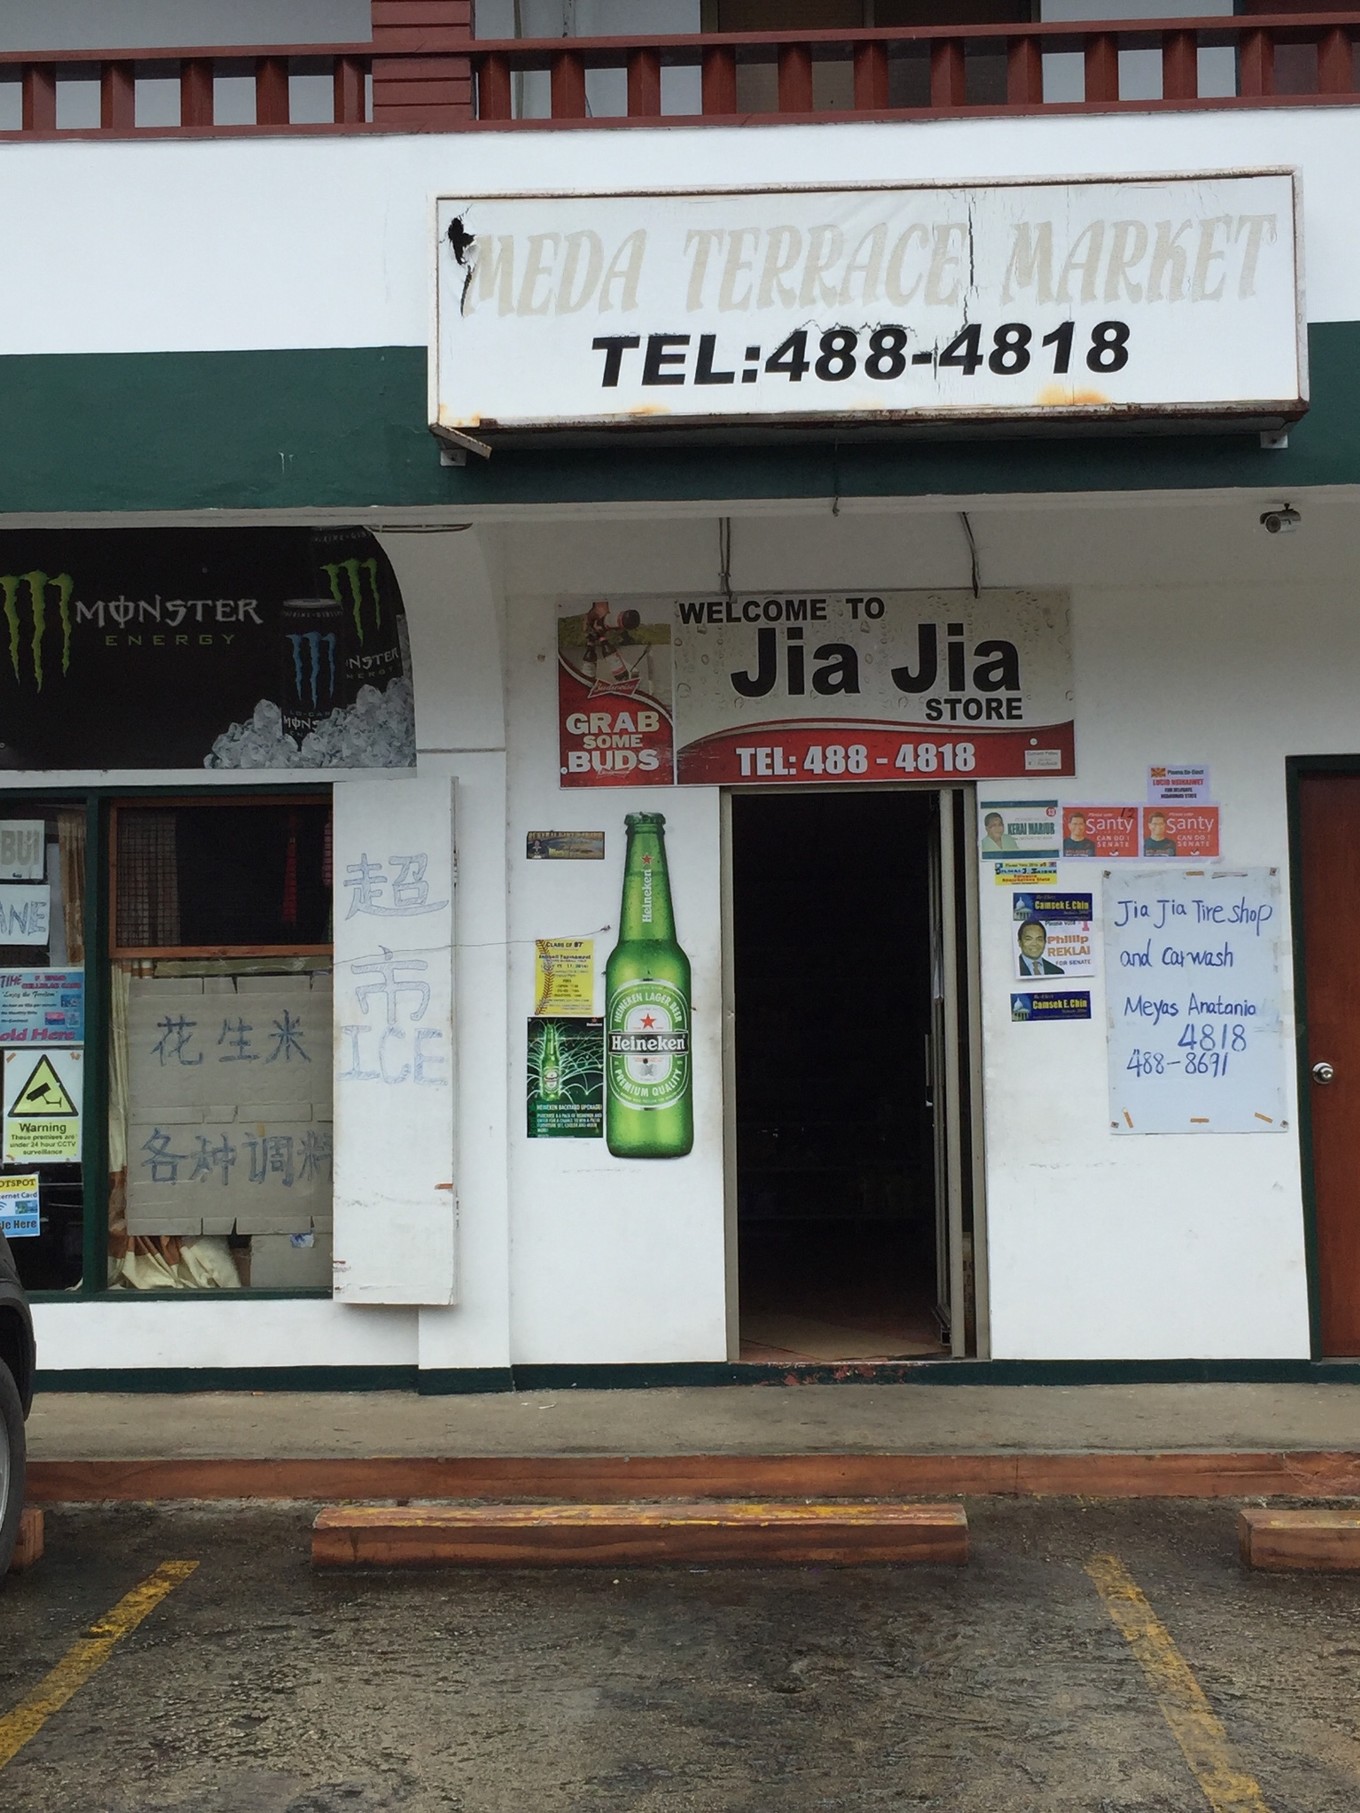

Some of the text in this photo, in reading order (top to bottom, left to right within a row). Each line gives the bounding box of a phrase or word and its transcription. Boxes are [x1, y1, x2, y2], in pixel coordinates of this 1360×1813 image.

[462, 213, 1278, 318] MEDA TERRACE MARKET
[679, 597, 886, 625] WELCOME TO
[105, 634, 236, 646] ENERGY
[729, 622, 1021, 698] Jia Jia
[925, 697, 1024, 721] STORE
[565, 711, 660, 735] GRAB
[582, 734, 643, 749] SOME
[568, 750, 660, 774] BUDS
[735, 747, 797, 776] TEL:
[803, 744, 869, 774] 488
[894, 742, 976, 772] 4818
[1085, 818, 1134, 835] Santy
[1166, 817, 1215, 834] Santy
[641, 869, 652, 923] Heineken
[1072, 900, 1089, 909] Chin
[1114, 899, 1150, 927] Jia
[1153, 899, 1187, 929] Jia
[1047, 946, 1091, 957] REKLAI
[1119, 938, 1153, 968] and
[613, 993, 643, 1023] HEINEKEN
[645, 992, 672, 1006] LAGER
[669, 1000, 683, 1023] BEER
[1032, 1000, 1063, 1010] Camsek
[1070, 998, 1088, 1008] Chin
[31, 1027, 75, 1041] Here
[150, 1008, 312, 1067] 花生米
[611, 1035, 686, 1051] Heineken
[1177, 1023, 1247, 1052] 4818
[336, 1025, 449, 1085] ICE
[615, 1068, 683, 1097] PREMIUM QUALITY
[19, 1122, 67, 1135] Warning
[13, 1219, 37, 1229] Here
